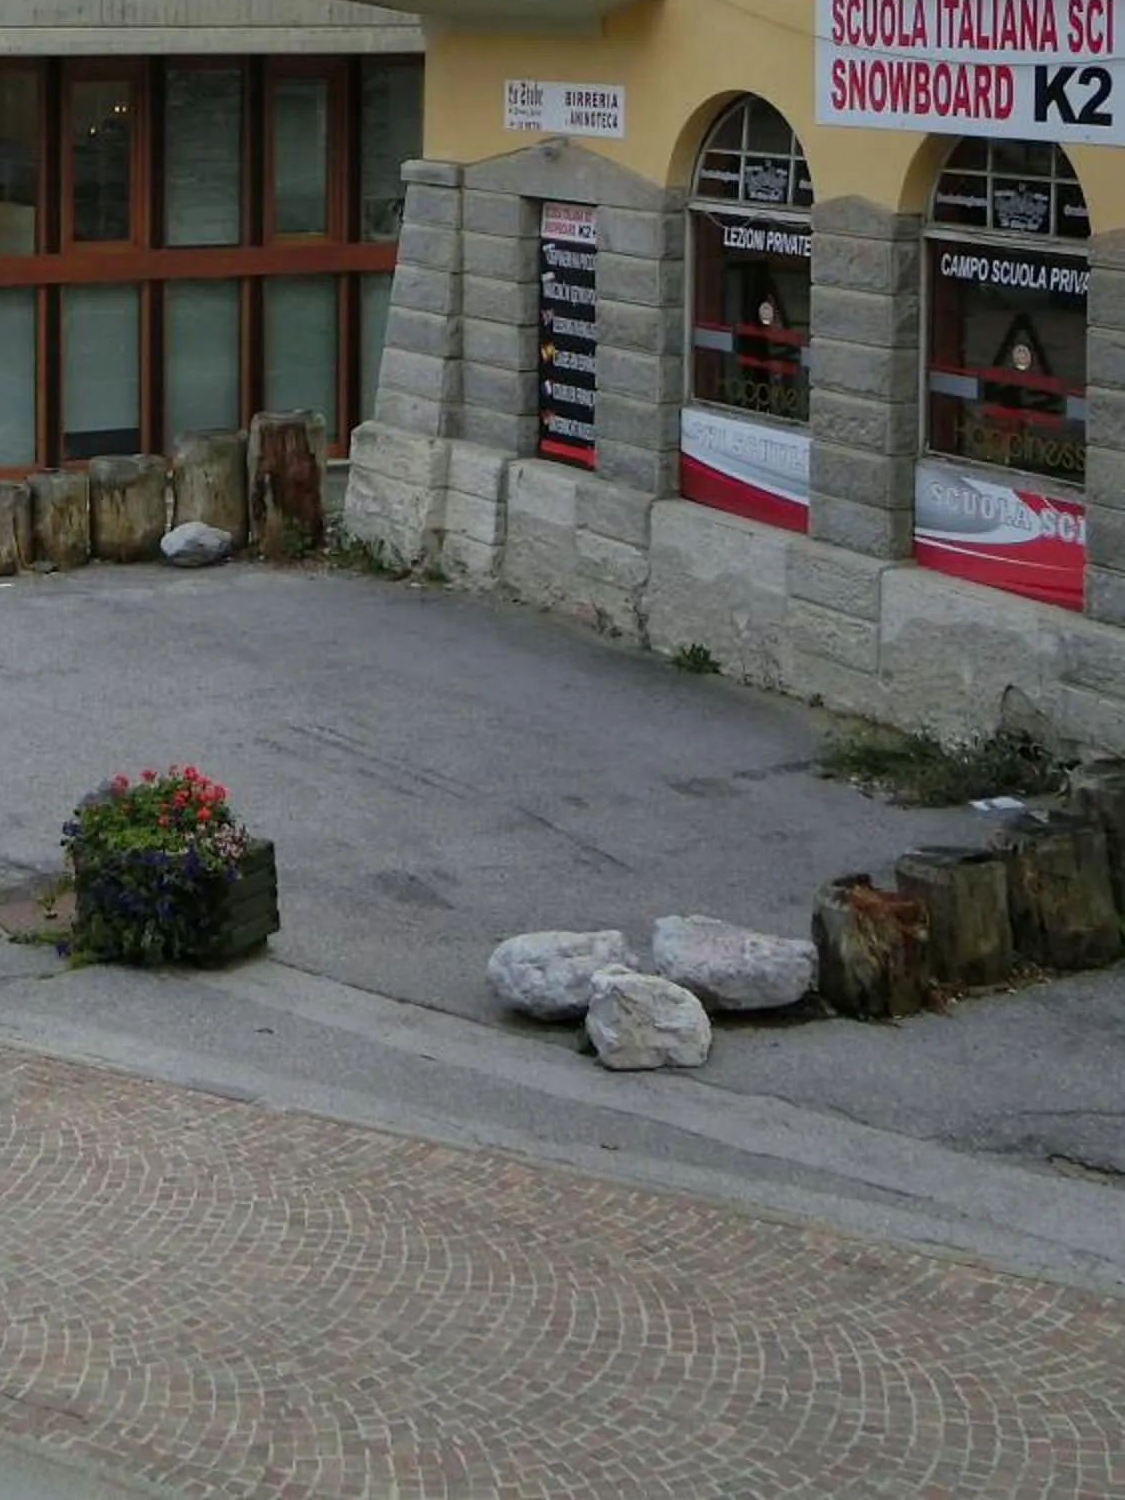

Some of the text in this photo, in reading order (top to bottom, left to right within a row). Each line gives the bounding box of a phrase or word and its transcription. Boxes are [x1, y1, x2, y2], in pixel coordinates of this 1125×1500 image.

[565, 91, 618, 108] BIRRERIA
[831, 58, 1114, 127] SNOWBOARD K2
[723, 227, 811, 257] LEZIONI PRIVATE
[940, 253, 989, 282] CAMPO
[991, 259, 1047, 290] SCUOLA
[927, 480, 1086, 545] SCUOLA SCI
